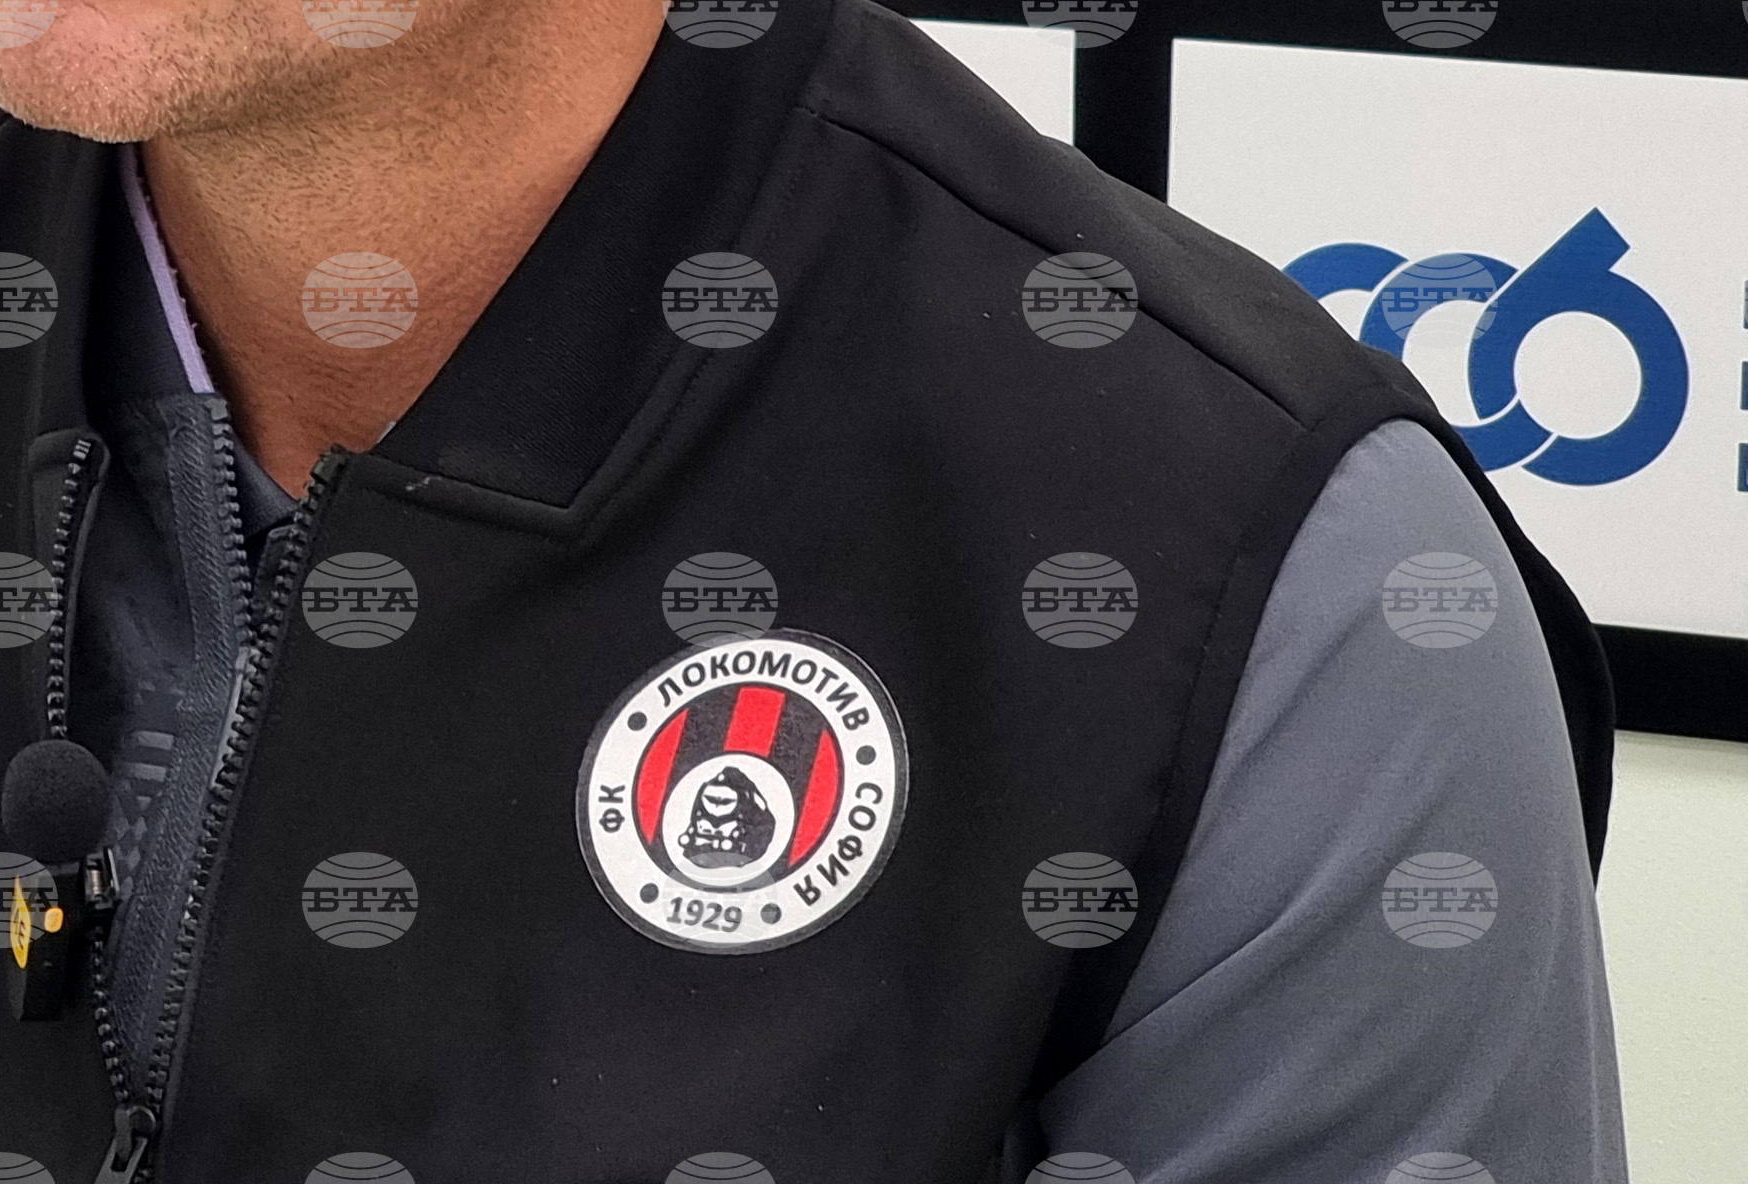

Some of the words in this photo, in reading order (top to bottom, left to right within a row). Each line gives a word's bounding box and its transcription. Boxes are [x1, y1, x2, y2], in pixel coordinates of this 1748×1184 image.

[657, 650, 870, 732] ЛОКОМОТИВ
[598, 783, 626, 834] ФК
[793, 781, 883, 908] СОФИЯ
[667, 896, 743, 933] 1929
